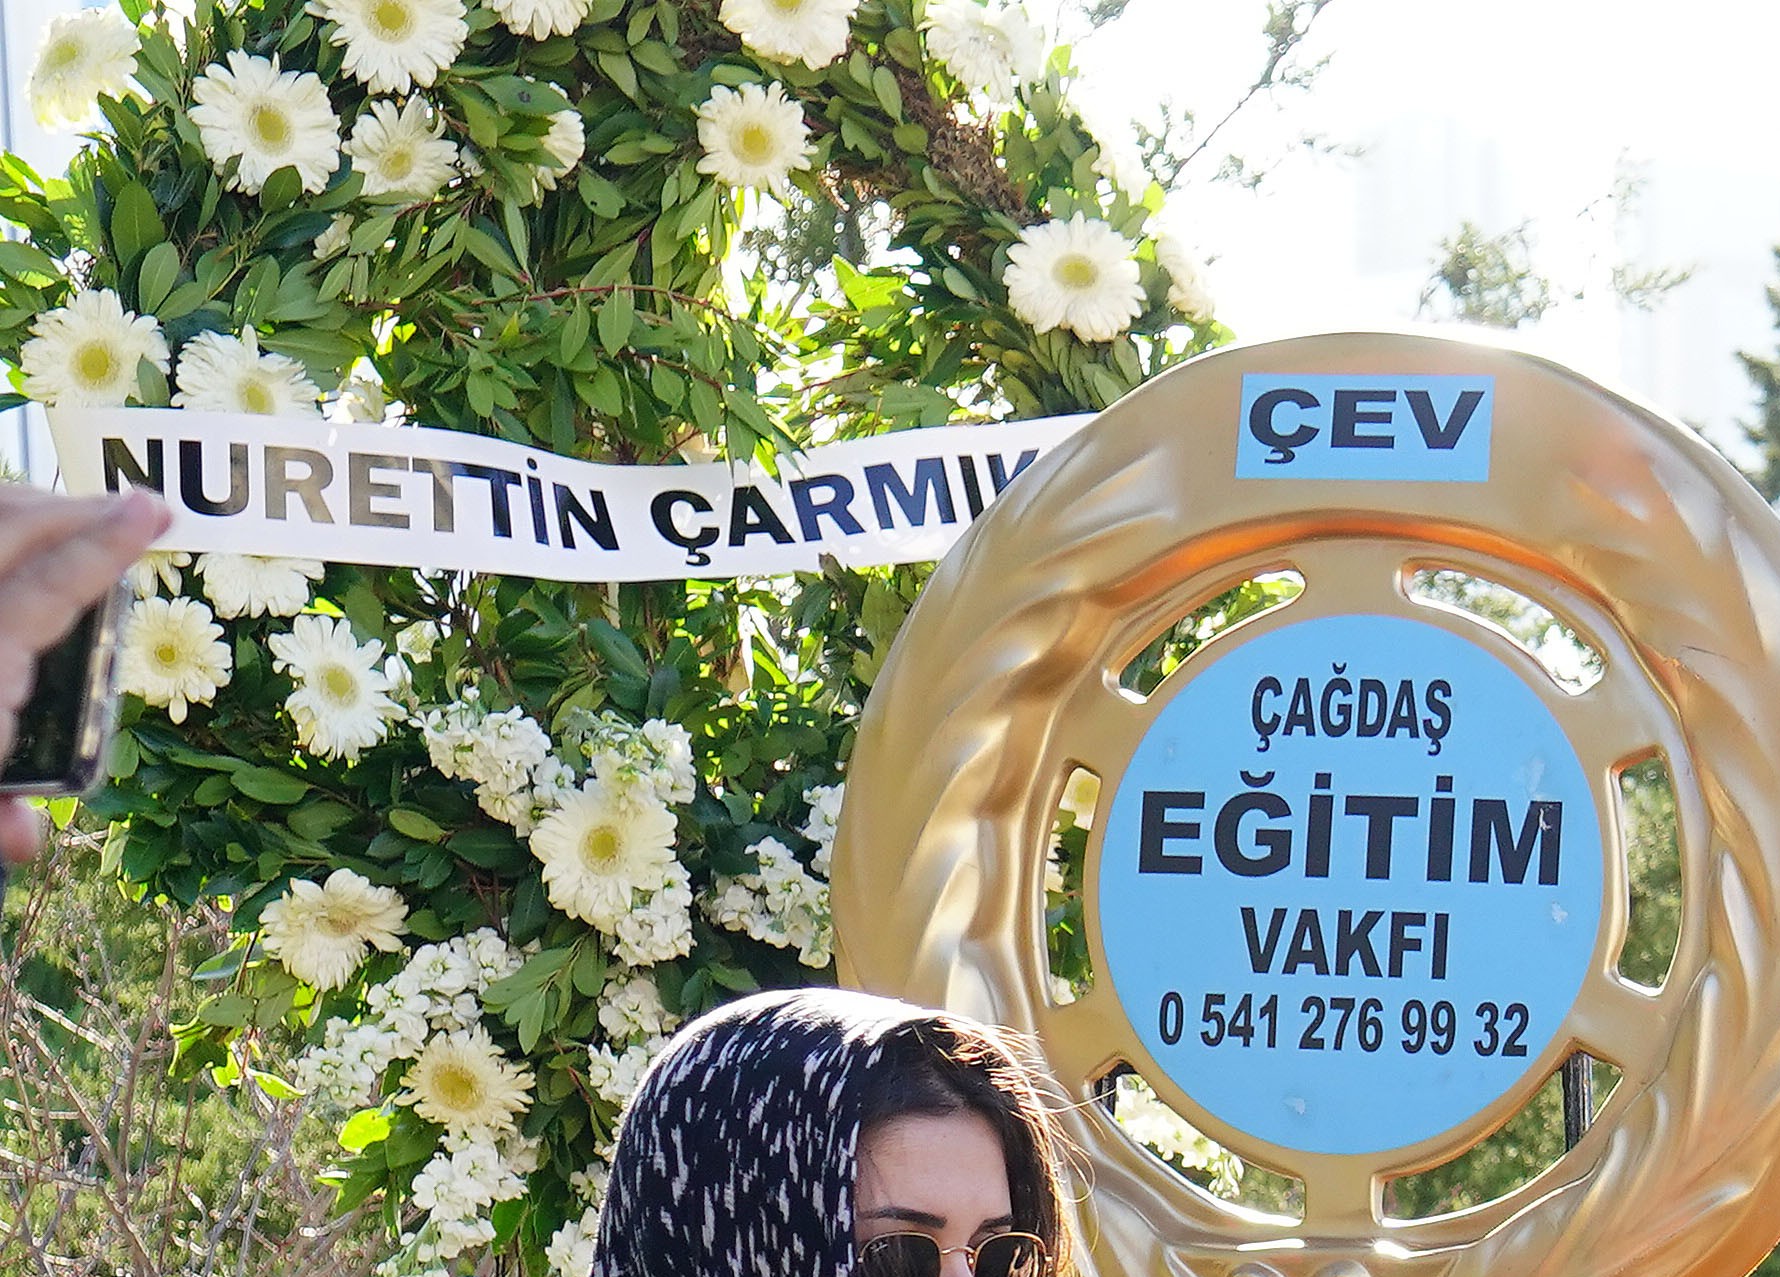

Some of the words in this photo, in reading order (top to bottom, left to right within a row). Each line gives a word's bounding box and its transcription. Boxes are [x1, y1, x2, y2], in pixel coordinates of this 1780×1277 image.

[1247, 387, 1485, 464] ÇEV
[102, 437, 618, 551] NURETTİN
[1250, 663, 1453, 756] ÇAĞDAŞ
[1137, 769, 1564, 887] EĞİTİM
[1240, 906, 1451, 981] VAKFI
[1158, 991, 1184, 1046] 0
[1200, 993, 1279, 1049] 541
[1298, 995, 1384, 1053] 276
[1401, 999, 1457, 1056] 99
[1473, 1002, 1530, 1058] 32
